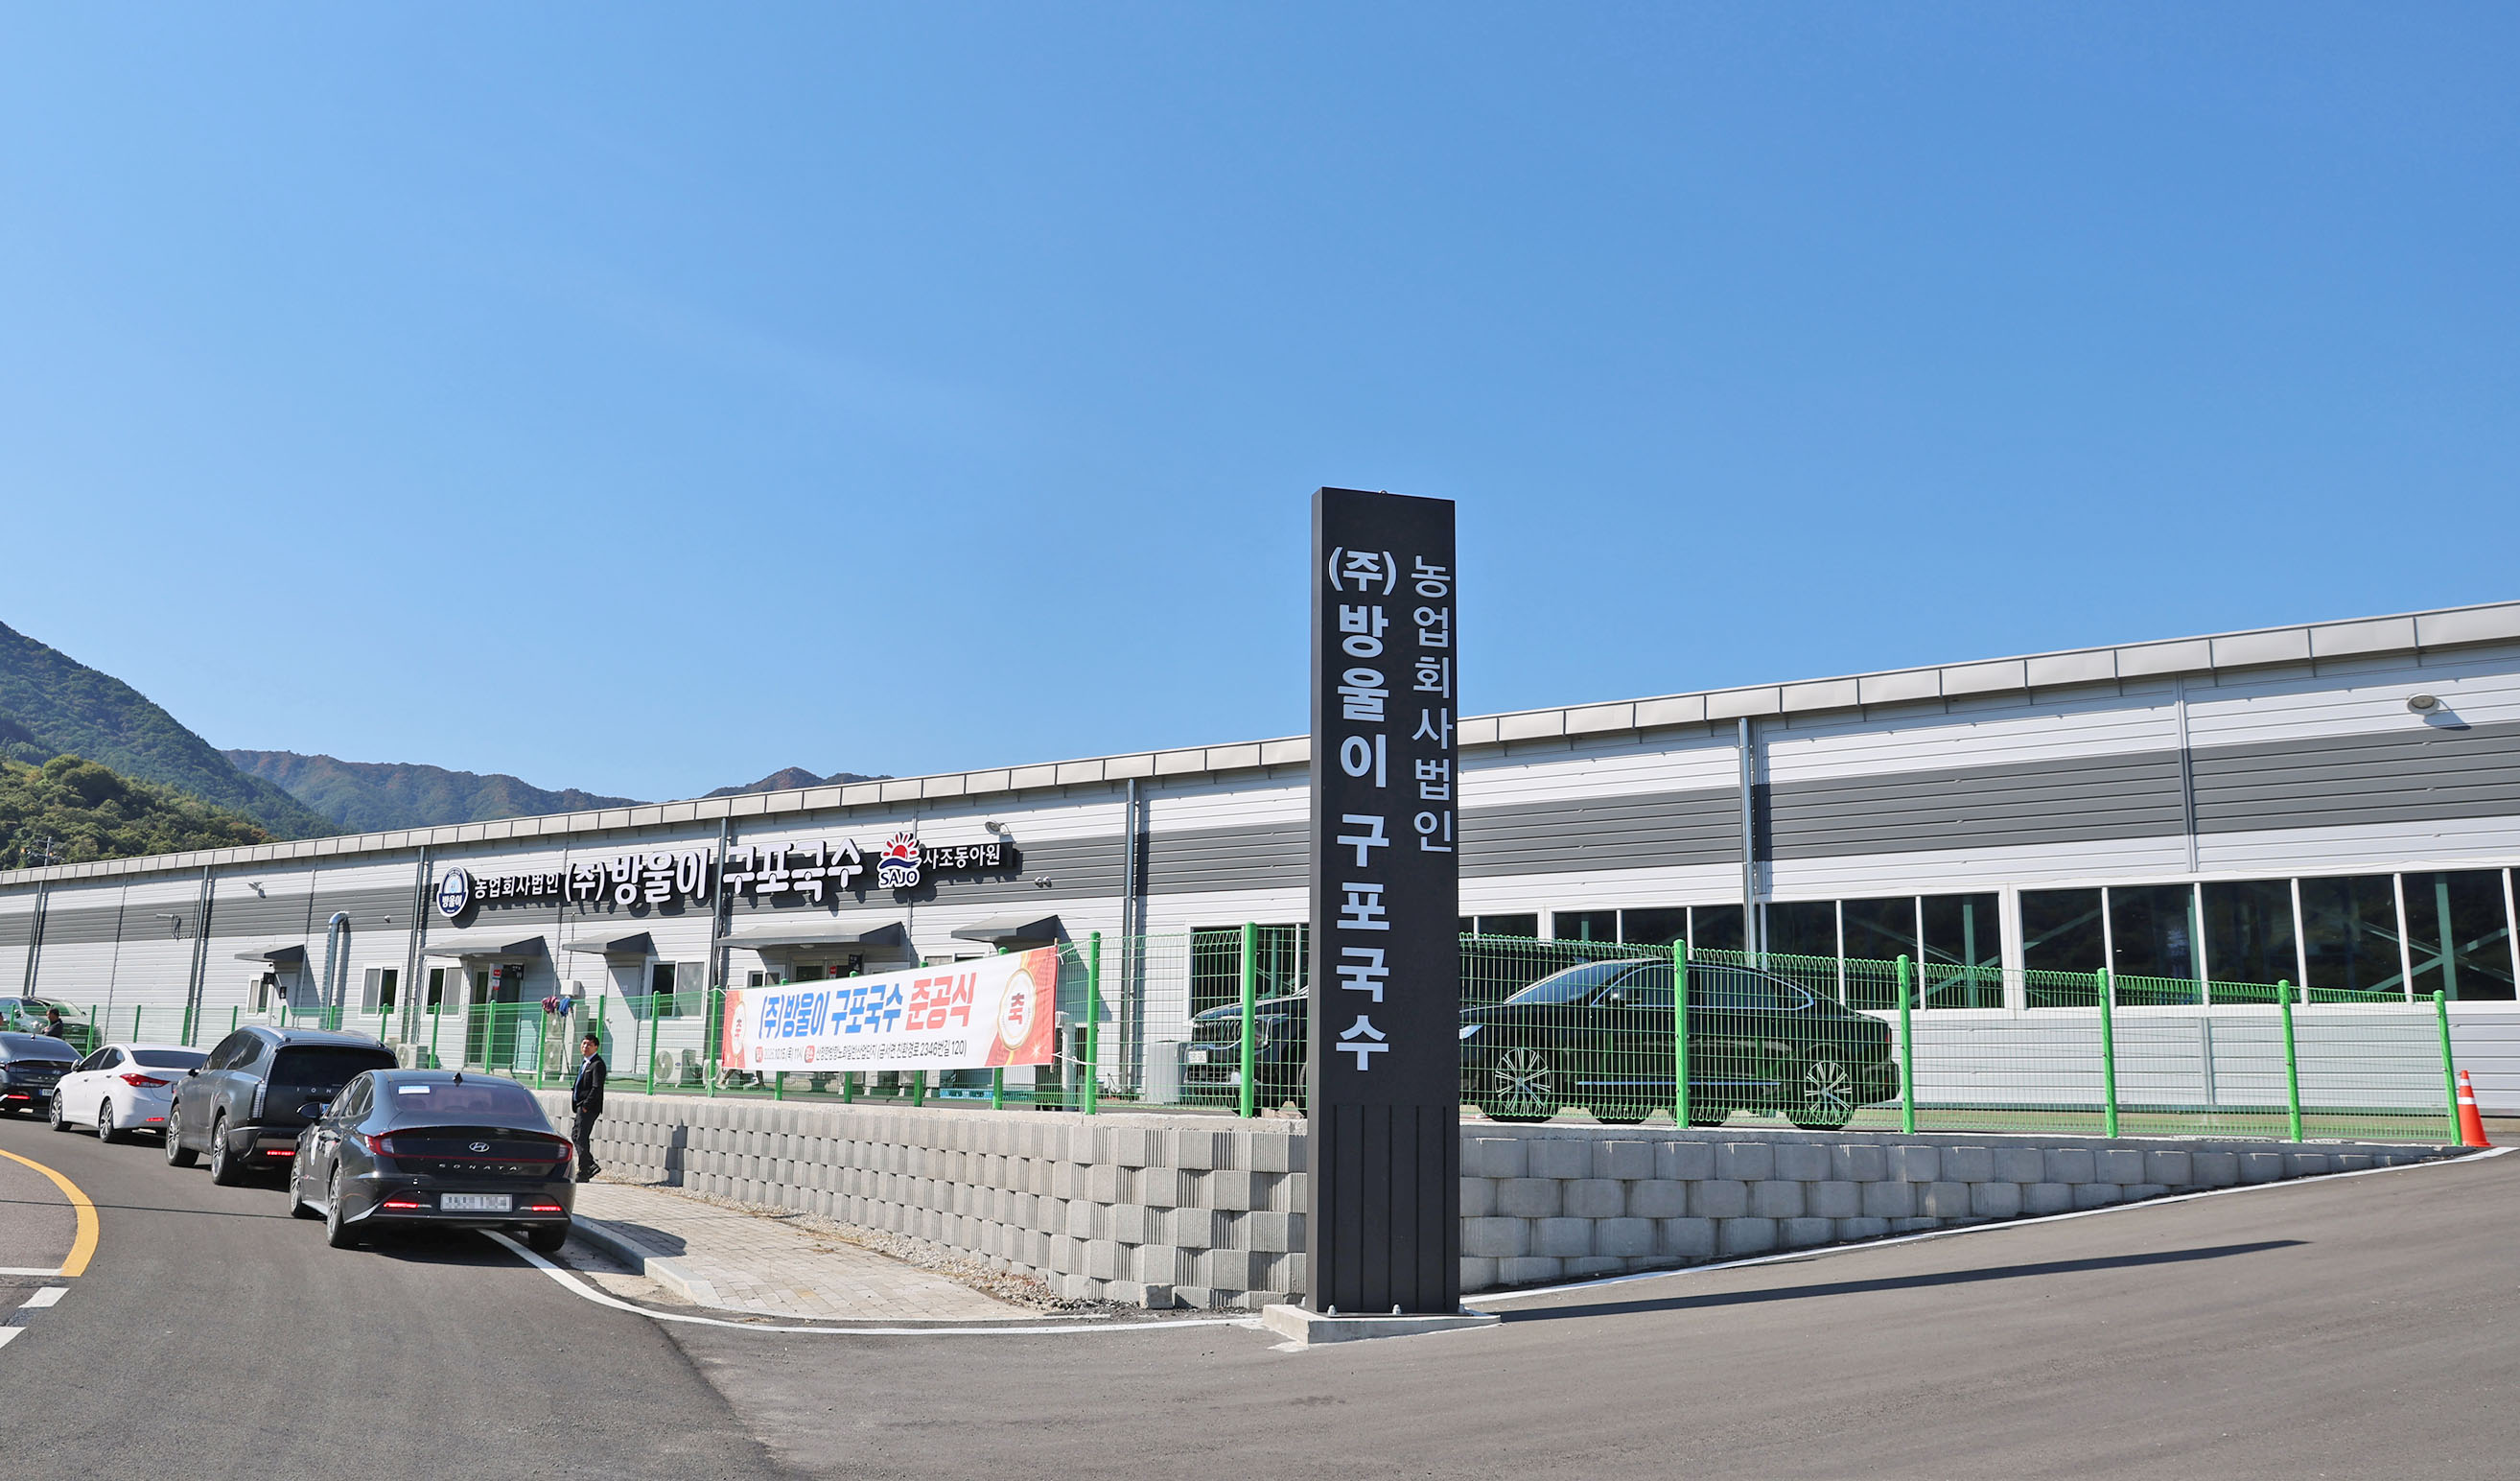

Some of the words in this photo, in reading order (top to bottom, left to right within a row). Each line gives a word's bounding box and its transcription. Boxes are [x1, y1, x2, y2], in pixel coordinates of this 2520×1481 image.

[1411, 554, 1453, 853] 농업회사법인
[474, 873, 559, 898] 농업회사법인
[723, 838, 863, 902] 구포국수
[923, 845, 1001, 870] 사조동아원
[879, 872, 918, 886] SAJO
[442, 895, 462, 908] 방울이
[1336, 813, 1389, 1071] 구포국수
[831, 983, 903, 1036] 구포국수
[905, 973, 976, 1030] 준공식
[1008, 993, 1024, 1024] 축
[951, 1039, 967, 1057] 120)
